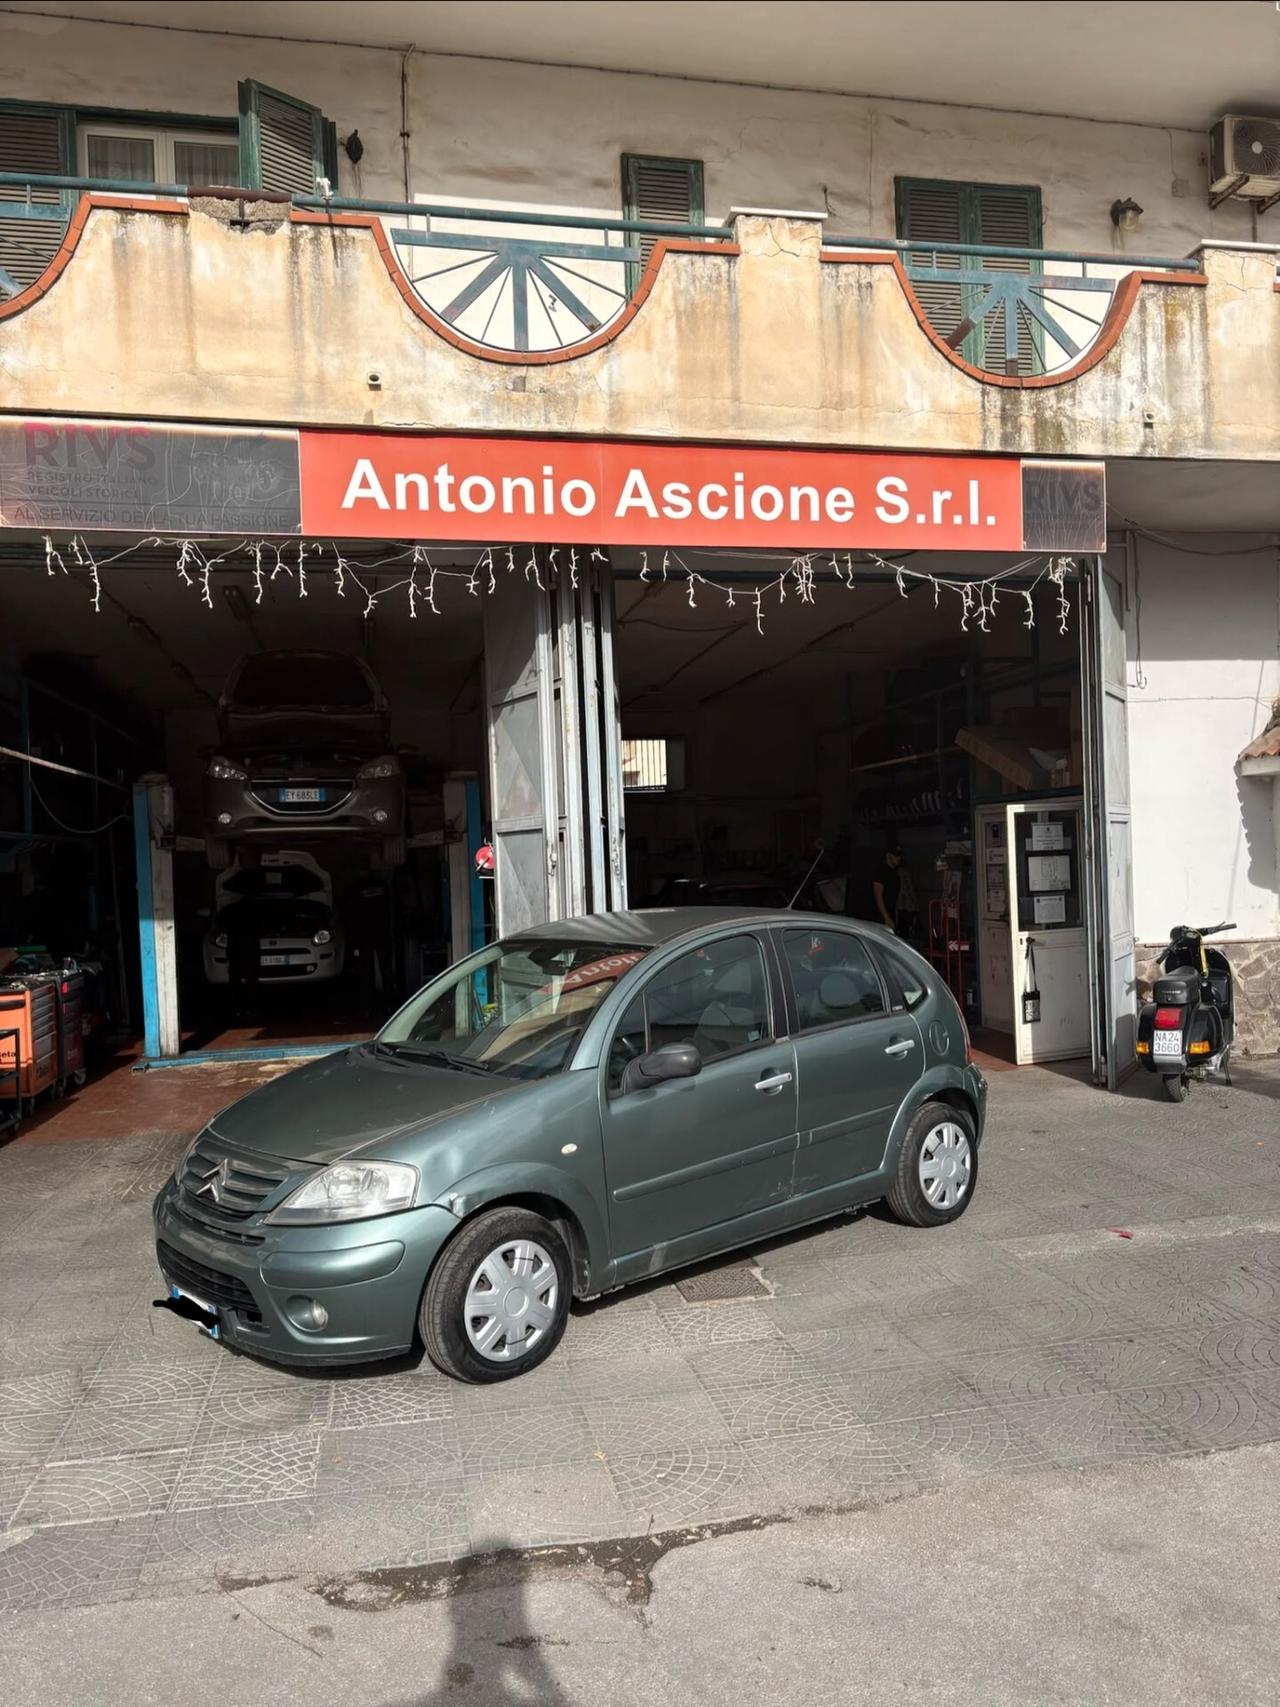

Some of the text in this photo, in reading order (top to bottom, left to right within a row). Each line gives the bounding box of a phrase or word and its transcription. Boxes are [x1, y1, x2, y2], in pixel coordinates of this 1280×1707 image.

[24, 422, 156, 471] RIVS
[341, 458, 996, 526] Antonio Ascione S.r.l.
[15, 506, 33, 520] AL
[40, 507, 116, 522] SERVIZIO
[211, 512, 289, 528] PASSIONE
[0, 1050, 17, 1058] eta
